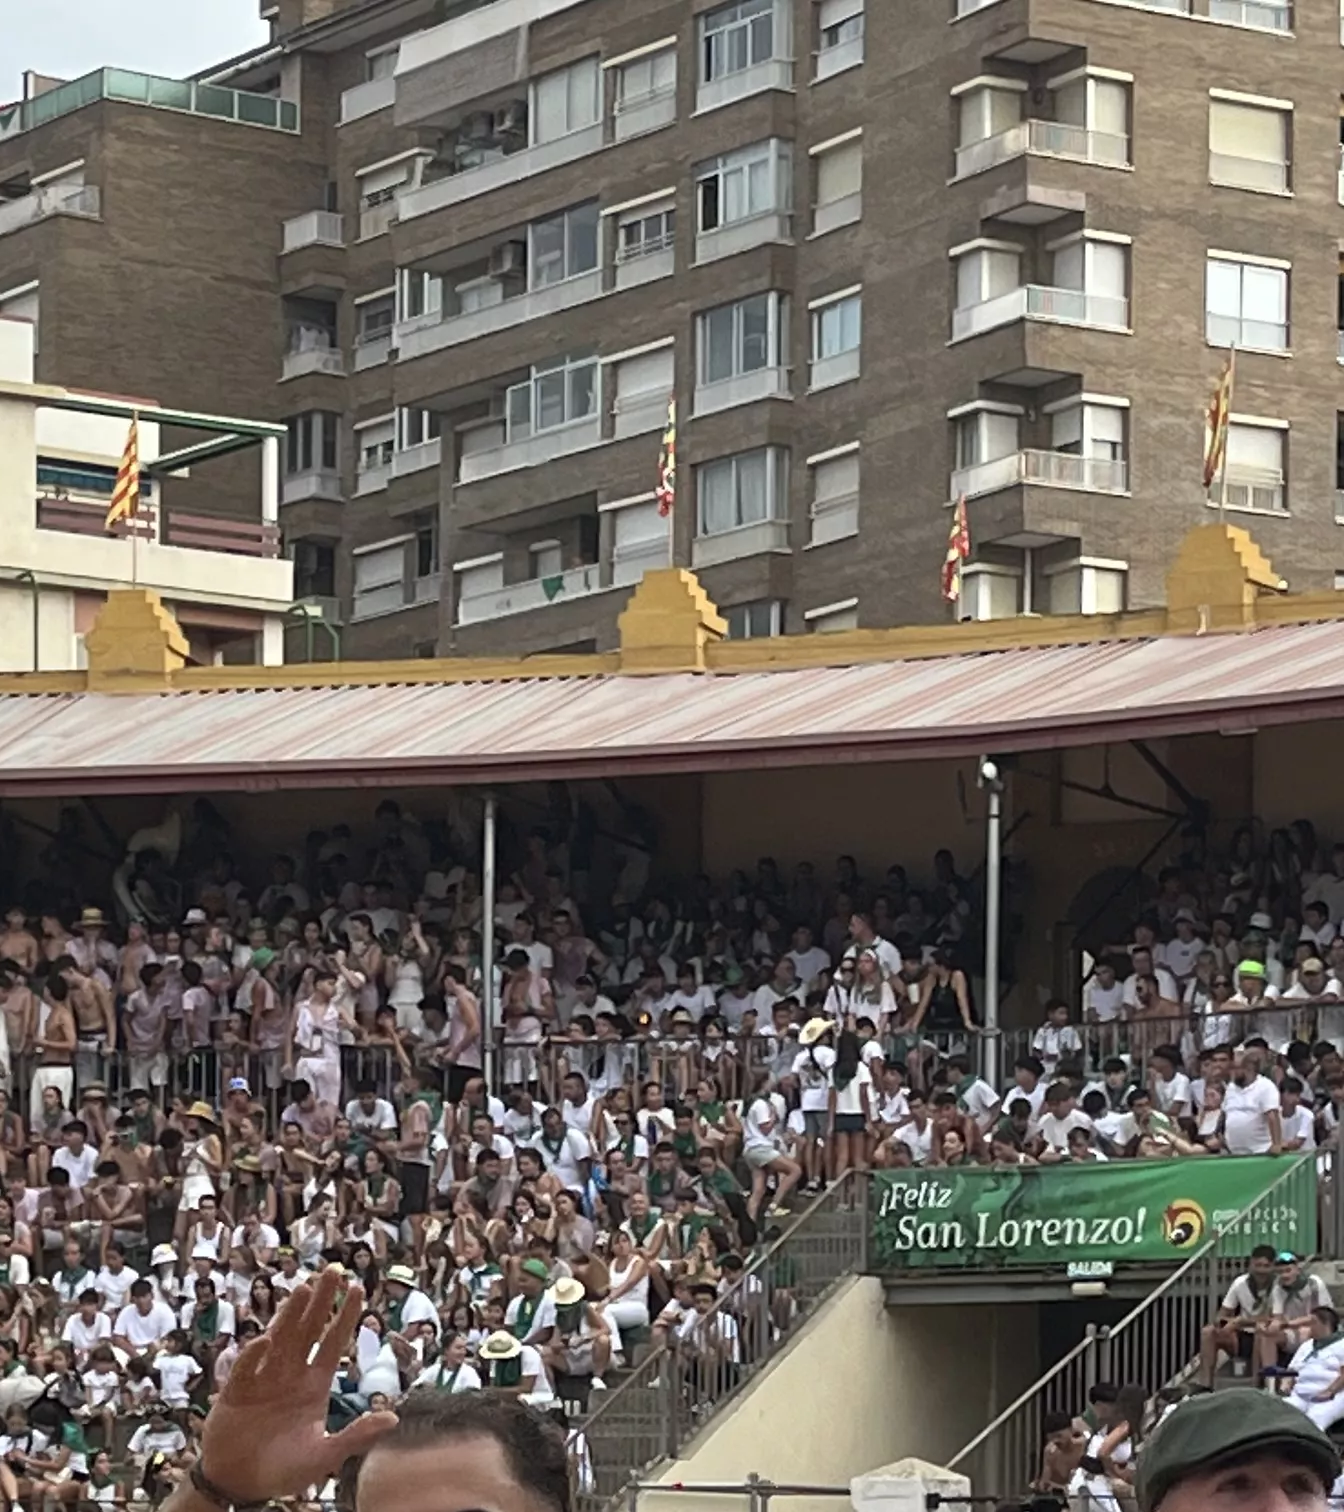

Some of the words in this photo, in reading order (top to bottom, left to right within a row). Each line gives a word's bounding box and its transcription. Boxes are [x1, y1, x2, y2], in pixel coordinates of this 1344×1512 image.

[895, 1215, 966, 1251] San
[975, 1206, 1147, 1249] Lorenzo!
[1067, 1261, 1113, 1277] SALIDA
